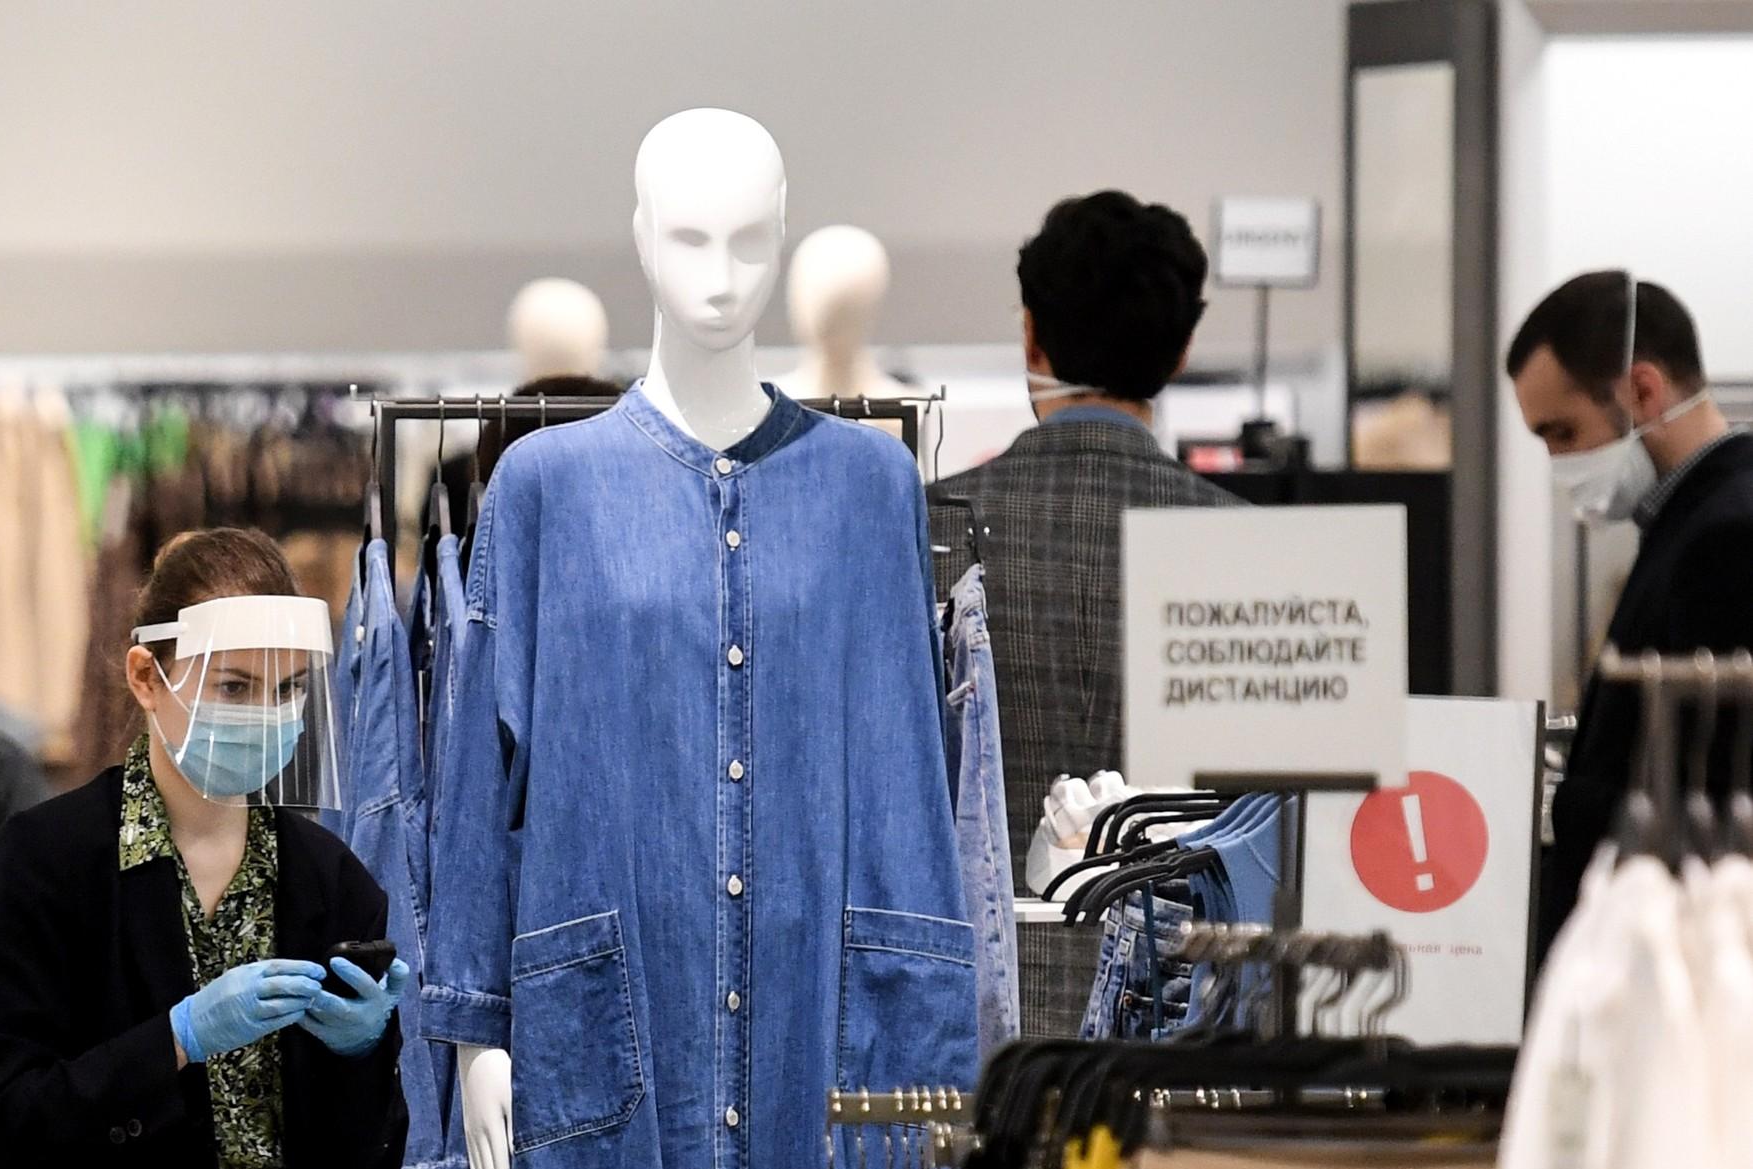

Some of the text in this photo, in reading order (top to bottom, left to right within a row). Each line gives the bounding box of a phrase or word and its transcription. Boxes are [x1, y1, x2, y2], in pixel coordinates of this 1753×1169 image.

[1165, 597, 1369, 628] ПОЖАЛУЙСТА,
[1166, 634, 1367, 667] СОБЛЮДАЙТЕ
[1166, 676, 1348, 706] ДИСТАНЦИЮ
